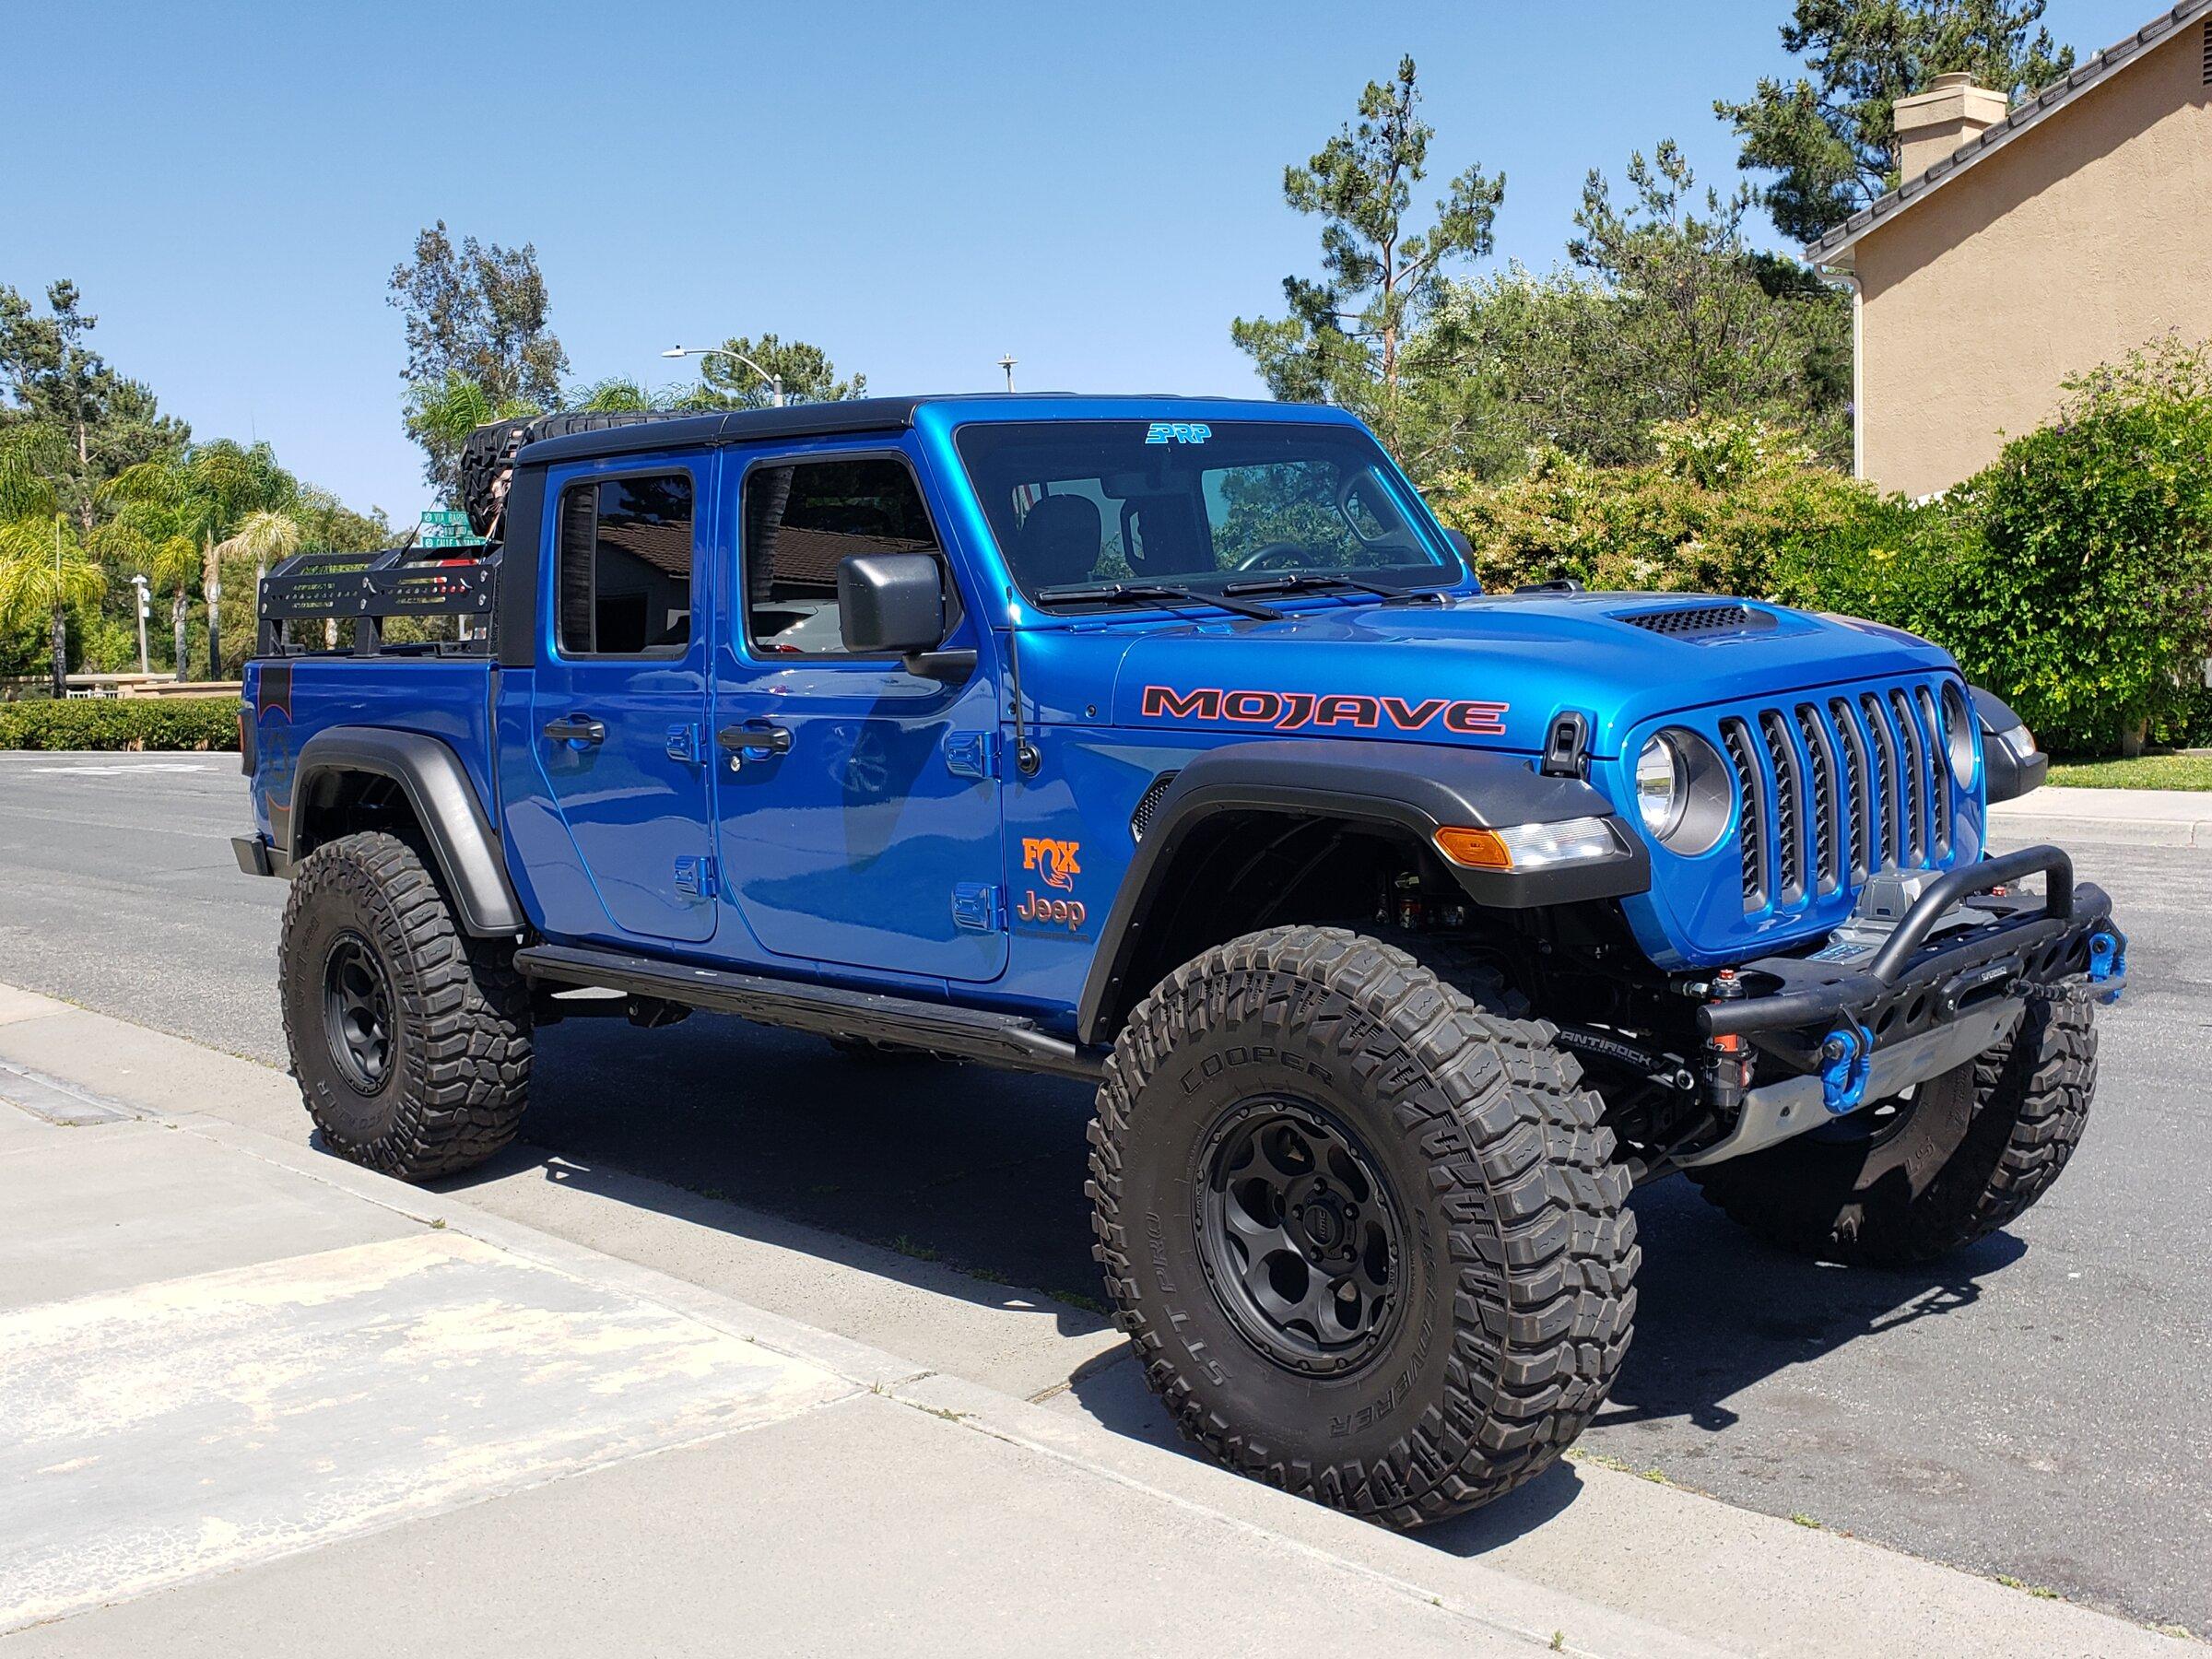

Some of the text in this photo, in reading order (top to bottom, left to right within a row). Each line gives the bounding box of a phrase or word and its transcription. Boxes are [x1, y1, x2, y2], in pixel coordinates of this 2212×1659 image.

[434, 512, 466, 523] VIA BARR
[1141, 685, 1511, 735] MOJAVE
[1021, 837, 1081, 892] FOX
[1016, 890, 1086, 931] Jeep
[1179, 1043, 1335, 1096] COOPER
[1560, 1030, 1652, 1066] ANTIROCK
[1145, 1210, 1233, 1387] STT PRO
[1328, 1206, 1437, 1440] DISCOVERER
